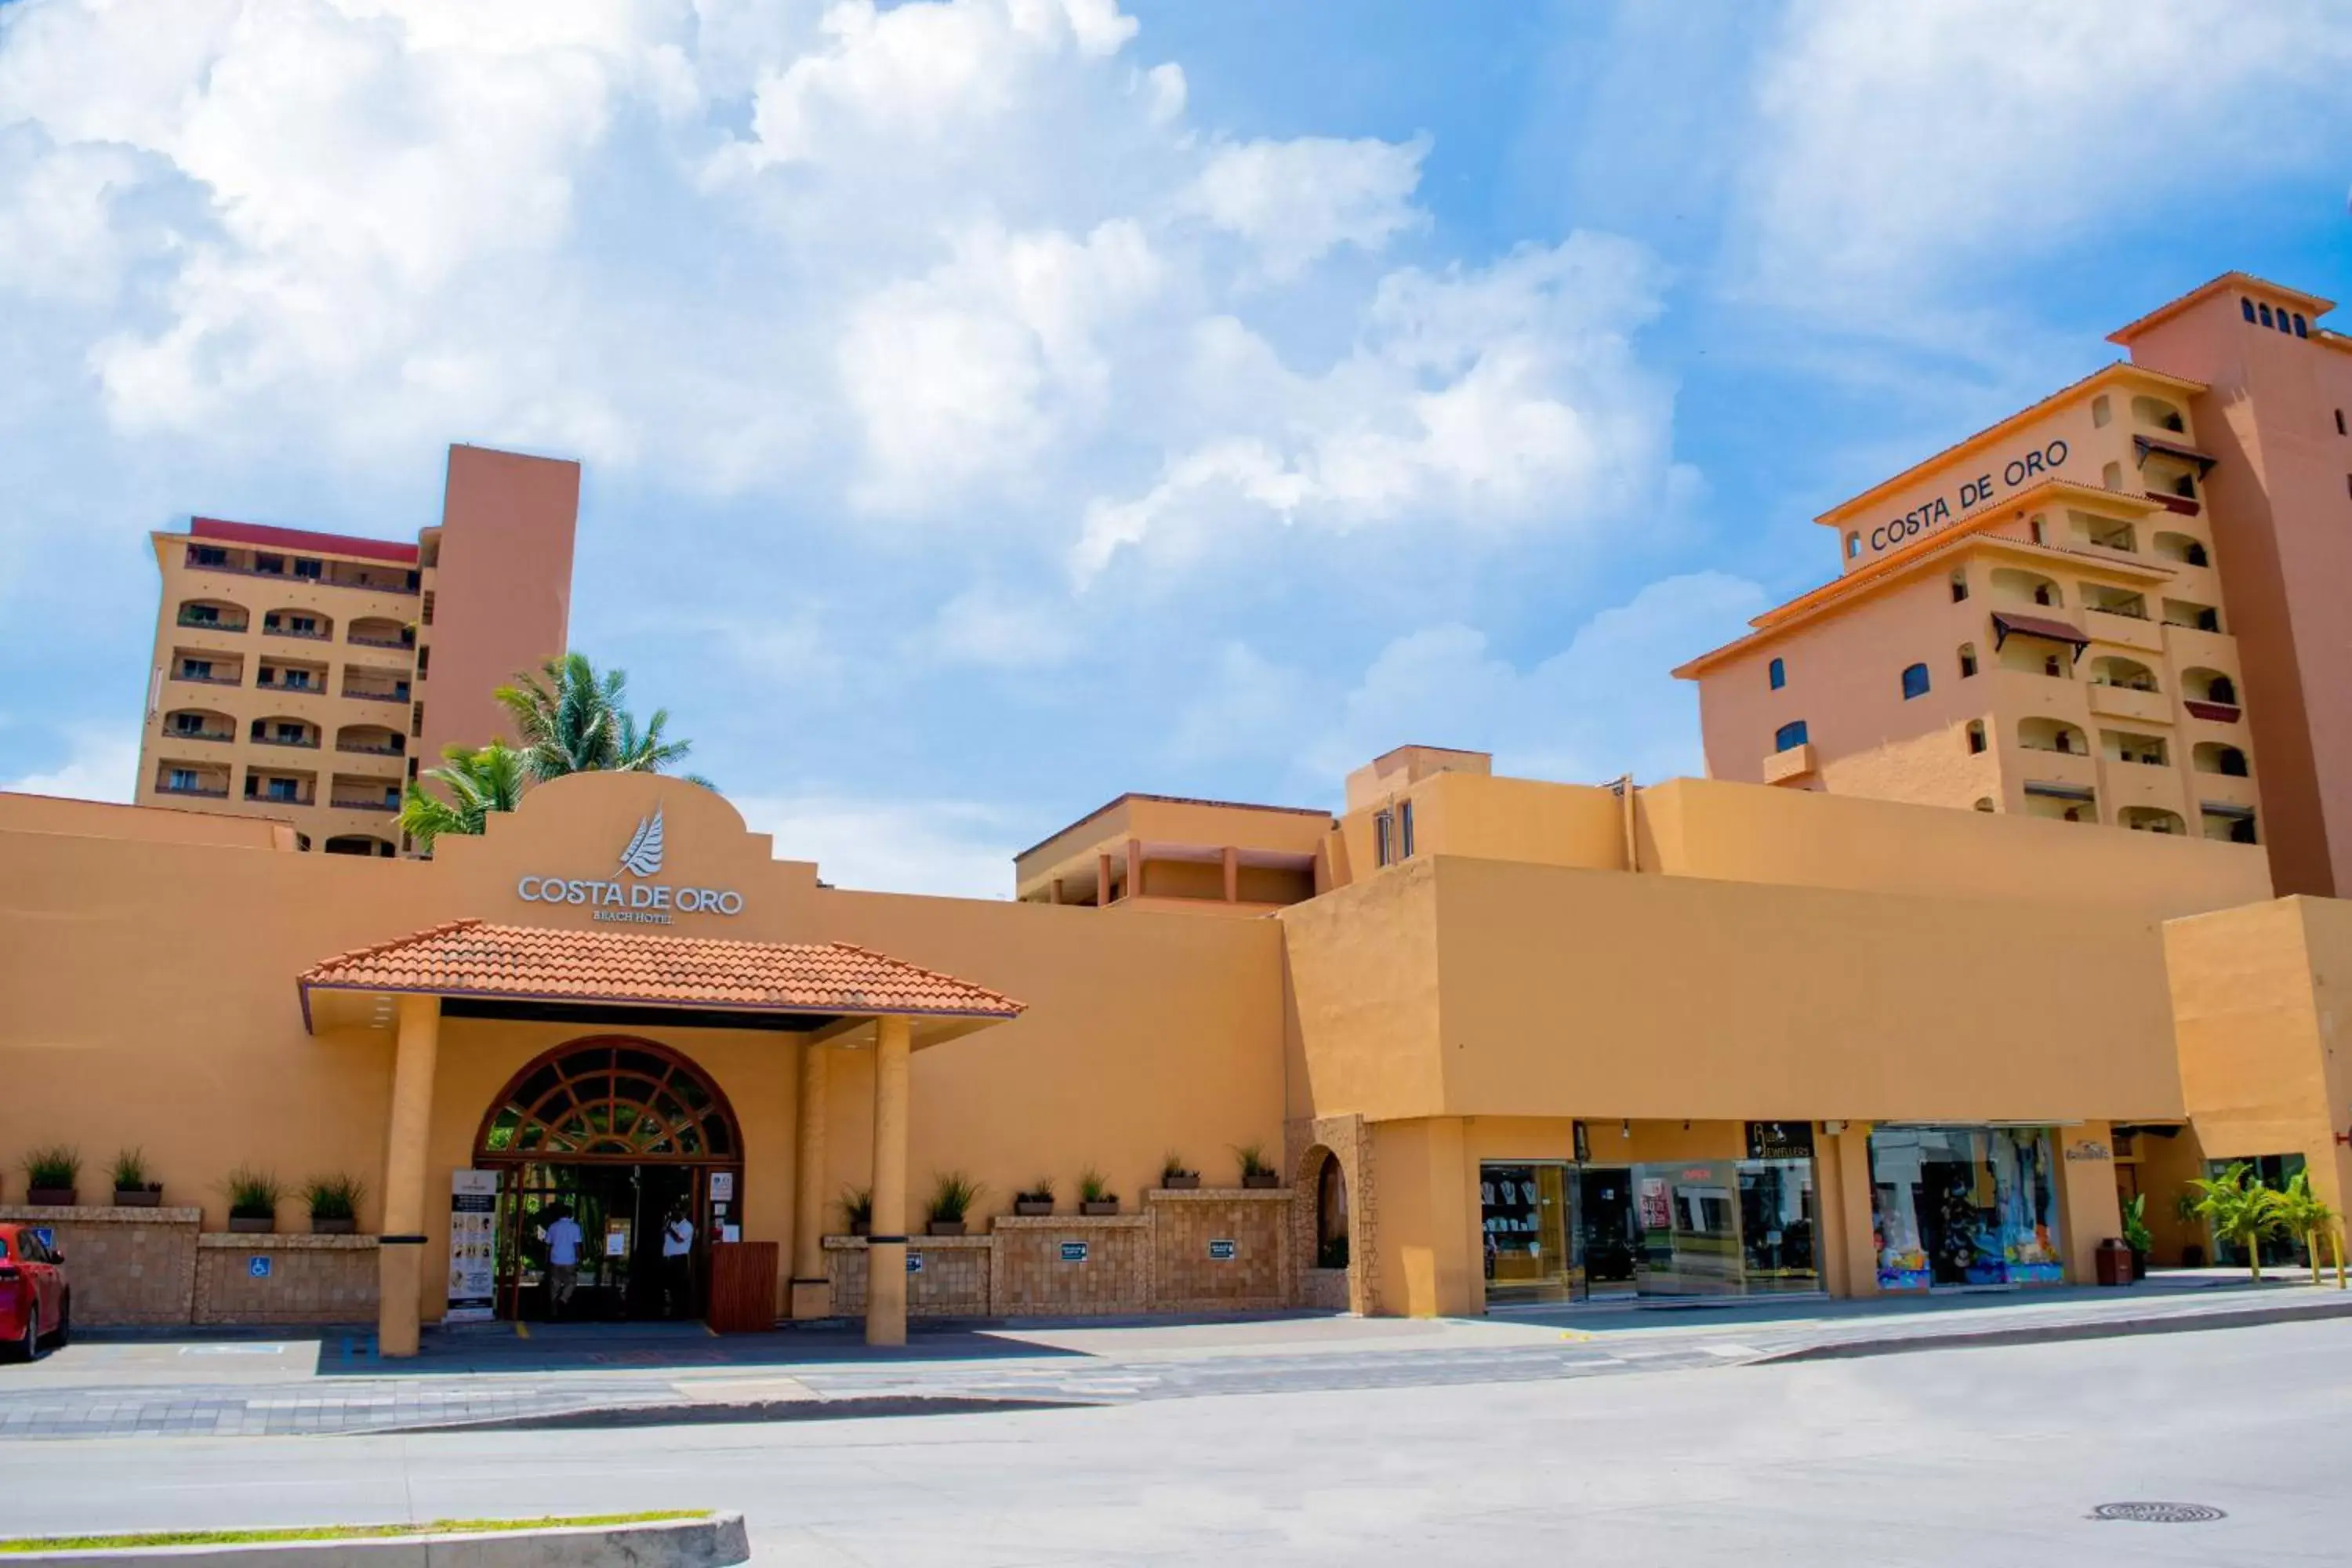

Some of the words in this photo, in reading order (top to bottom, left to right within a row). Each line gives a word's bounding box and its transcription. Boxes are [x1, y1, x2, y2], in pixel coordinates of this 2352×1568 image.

[1871, 496, 1951, 551] COSTA
[1958, 474, 1994, 510] DE
[2003, 440, 2068, 487] ORO
[517, 876, 626, 907] COSTA
[630, 884, 672, 909] DE
[675, 887, 743, 915] ORO
[593, 910, 632, 922] BEACH
[635, 913, 675, 925] HOTEL
